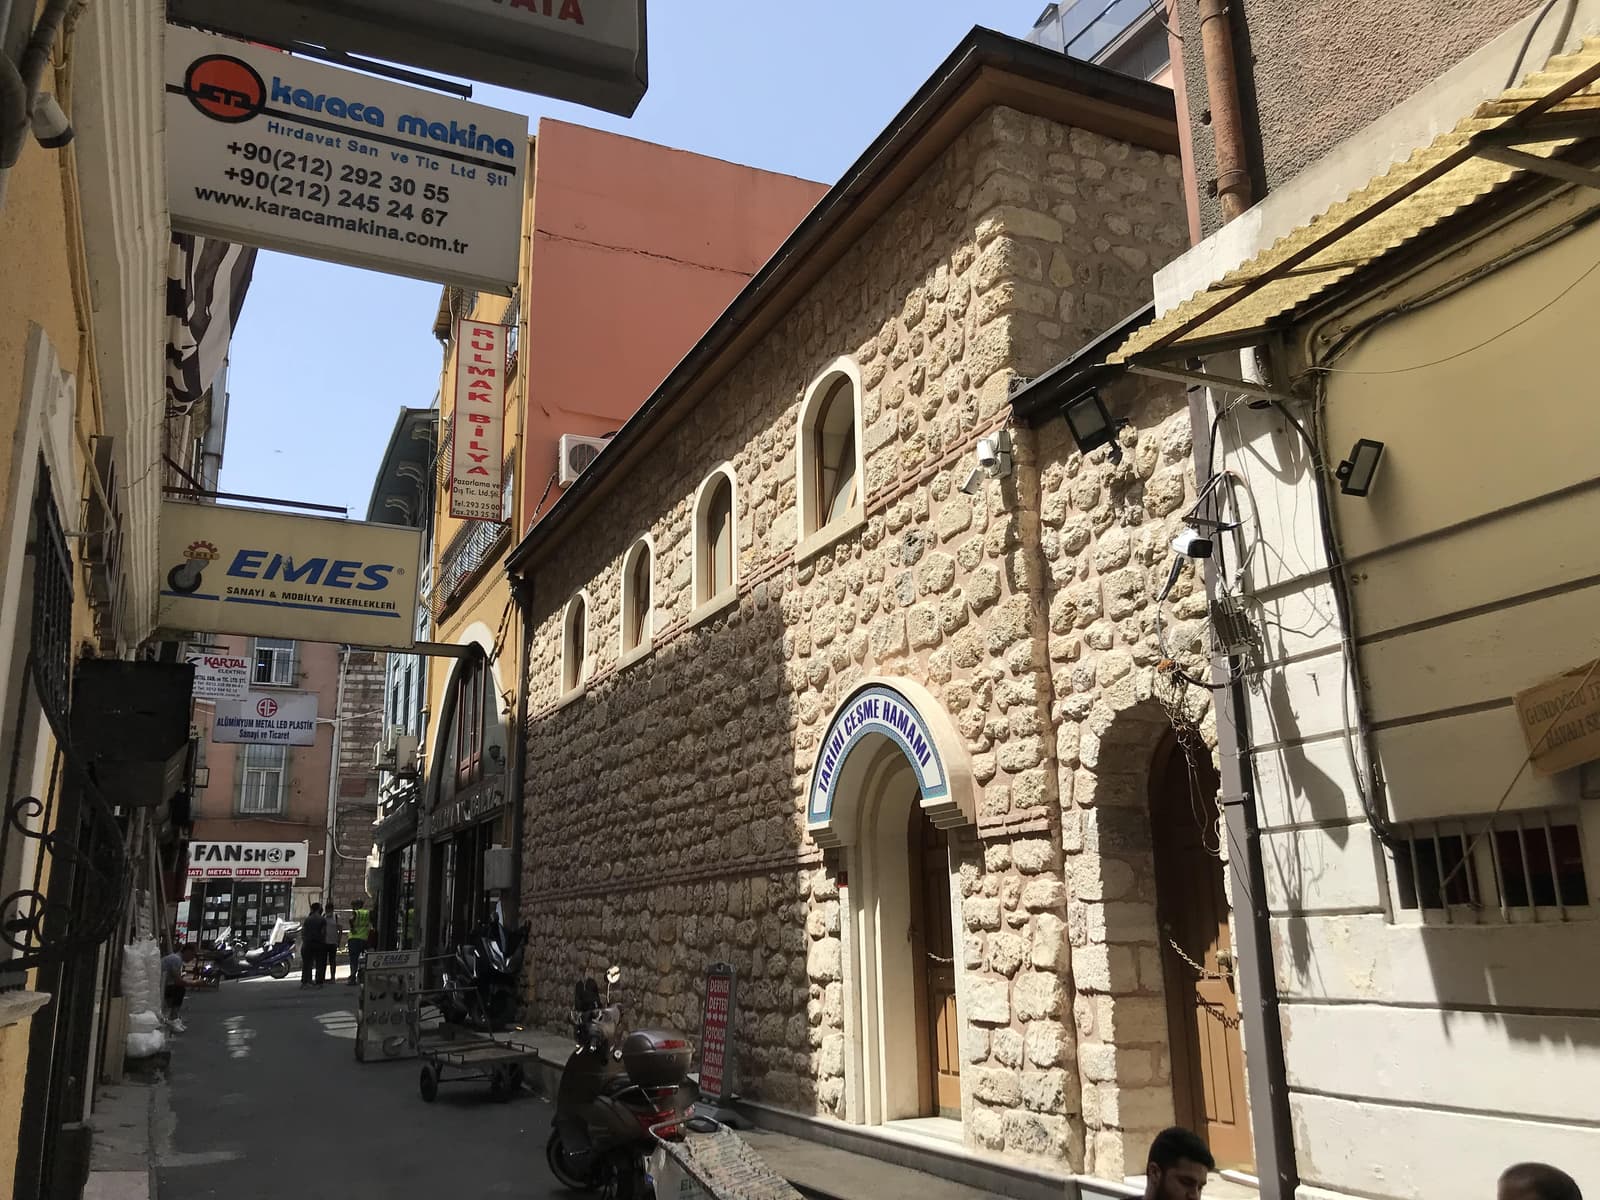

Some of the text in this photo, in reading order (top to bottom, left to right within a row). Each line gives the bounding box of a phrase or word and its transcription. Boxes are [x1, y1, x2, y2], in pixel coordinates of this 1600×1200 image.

[271, 76, 385, 127] karaca
[397, 114, 515, 159] makina
[227, 142, 450, 204] +90(212) 292 30 55
[267, 120, 341, 149] Hırdavat
[347, 140, 379, 157] San
[391, 151, 409, 164] ve
[451, 164, 476, 180] Ltd
[195, 186, 469, 254] www.karacamakina.com.tr
[224, 167, 448, 227] +90(212) 245 24 67
[468, 327, 496, 403] RULMAK
[466, 413, 491, 476] BİLYA
[453, 478, 491, 488] Pazarlama
[226, 549, 395, 591] EMES
[226, 586, 265, 598] SANAYİ
[281, 591, 324, 604] MOBİLYA
[329, 596, 396, 610] TEKERLEKLERİ
[204, 656, 247, 669] KARTAL
[216, 715, 314, 730] ALÜMİNYUM METAL LED PLASTİK
[239, 729, 290, 740] Sanayi ve Ticaret
[843, 699, 880, 737] ÇEŞME
[882, 700, 931, 768] HAMAMI
